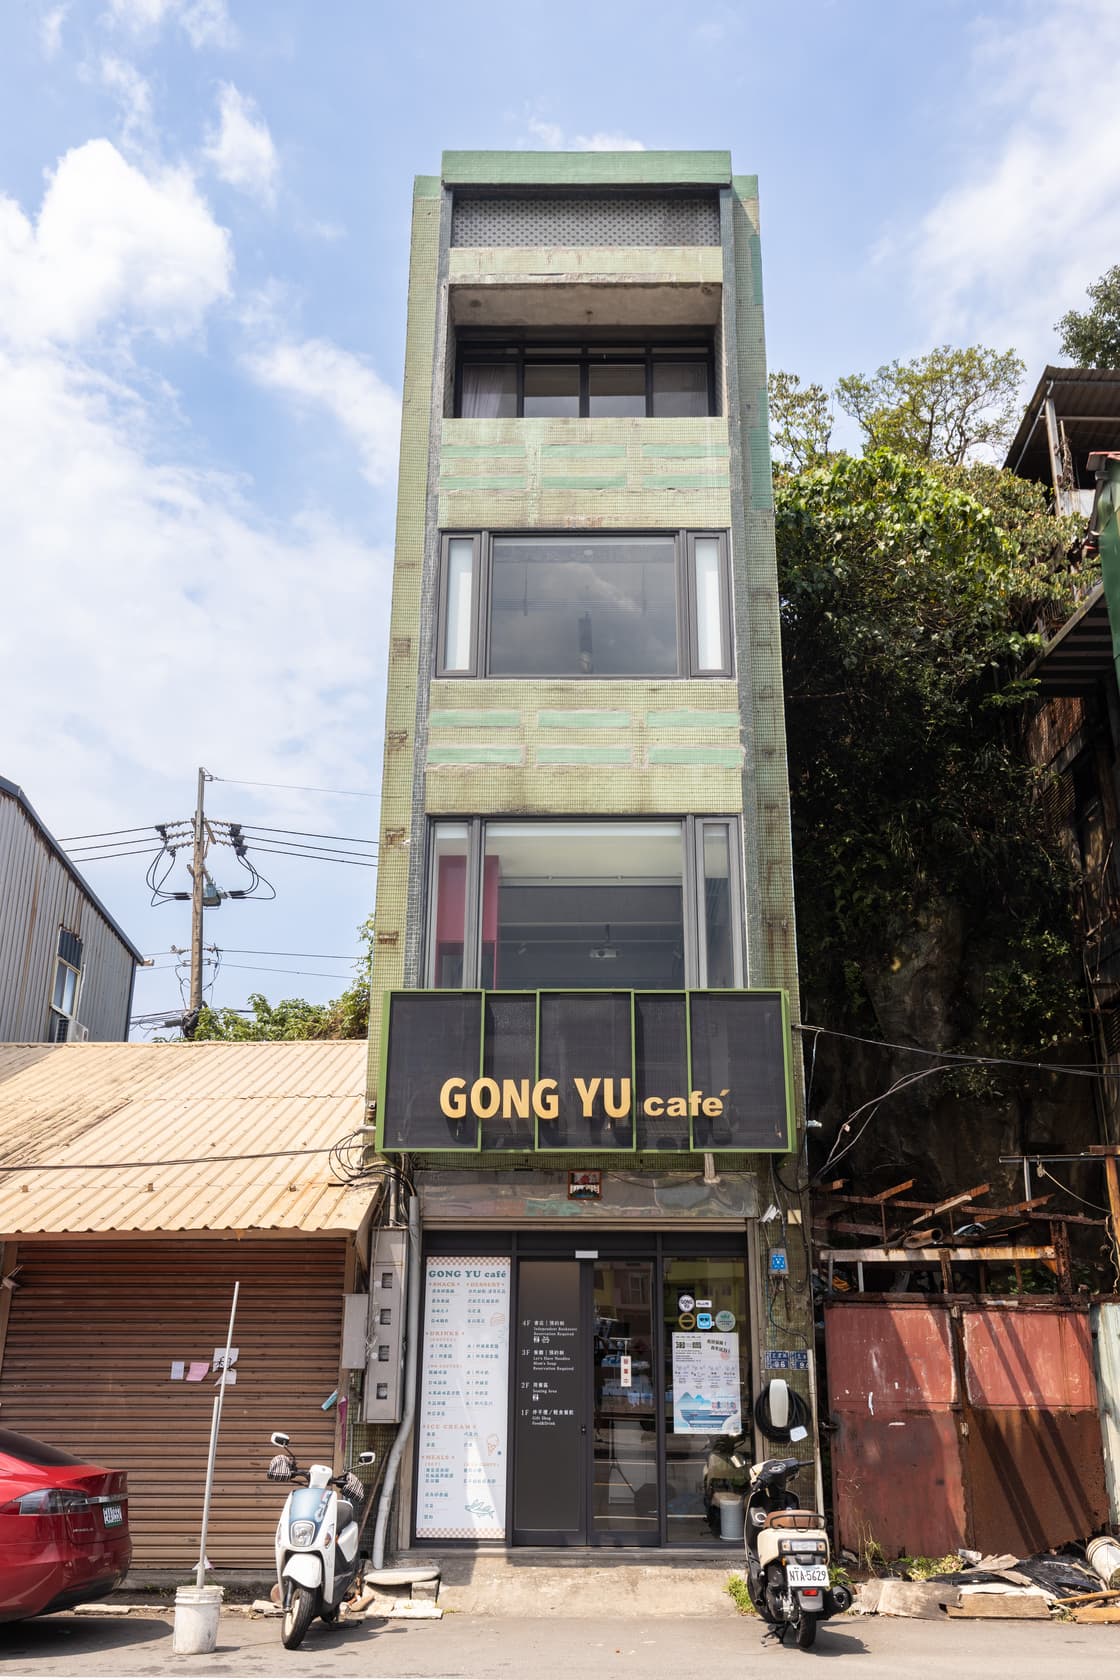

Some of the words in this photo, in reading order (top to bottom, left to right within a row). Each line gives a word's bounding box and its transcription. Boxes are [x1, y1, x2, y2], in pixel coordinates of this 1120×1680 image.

[439, 1076, 559, 1120] GONG
[574, 1077, 631, 1119] YU
[643, 1088, 731, 1117] café
[428, 1270, 461, 1278] GONG
[465, 1270, 481, 1278] YU
[484, 1270, 507, 1278] café
